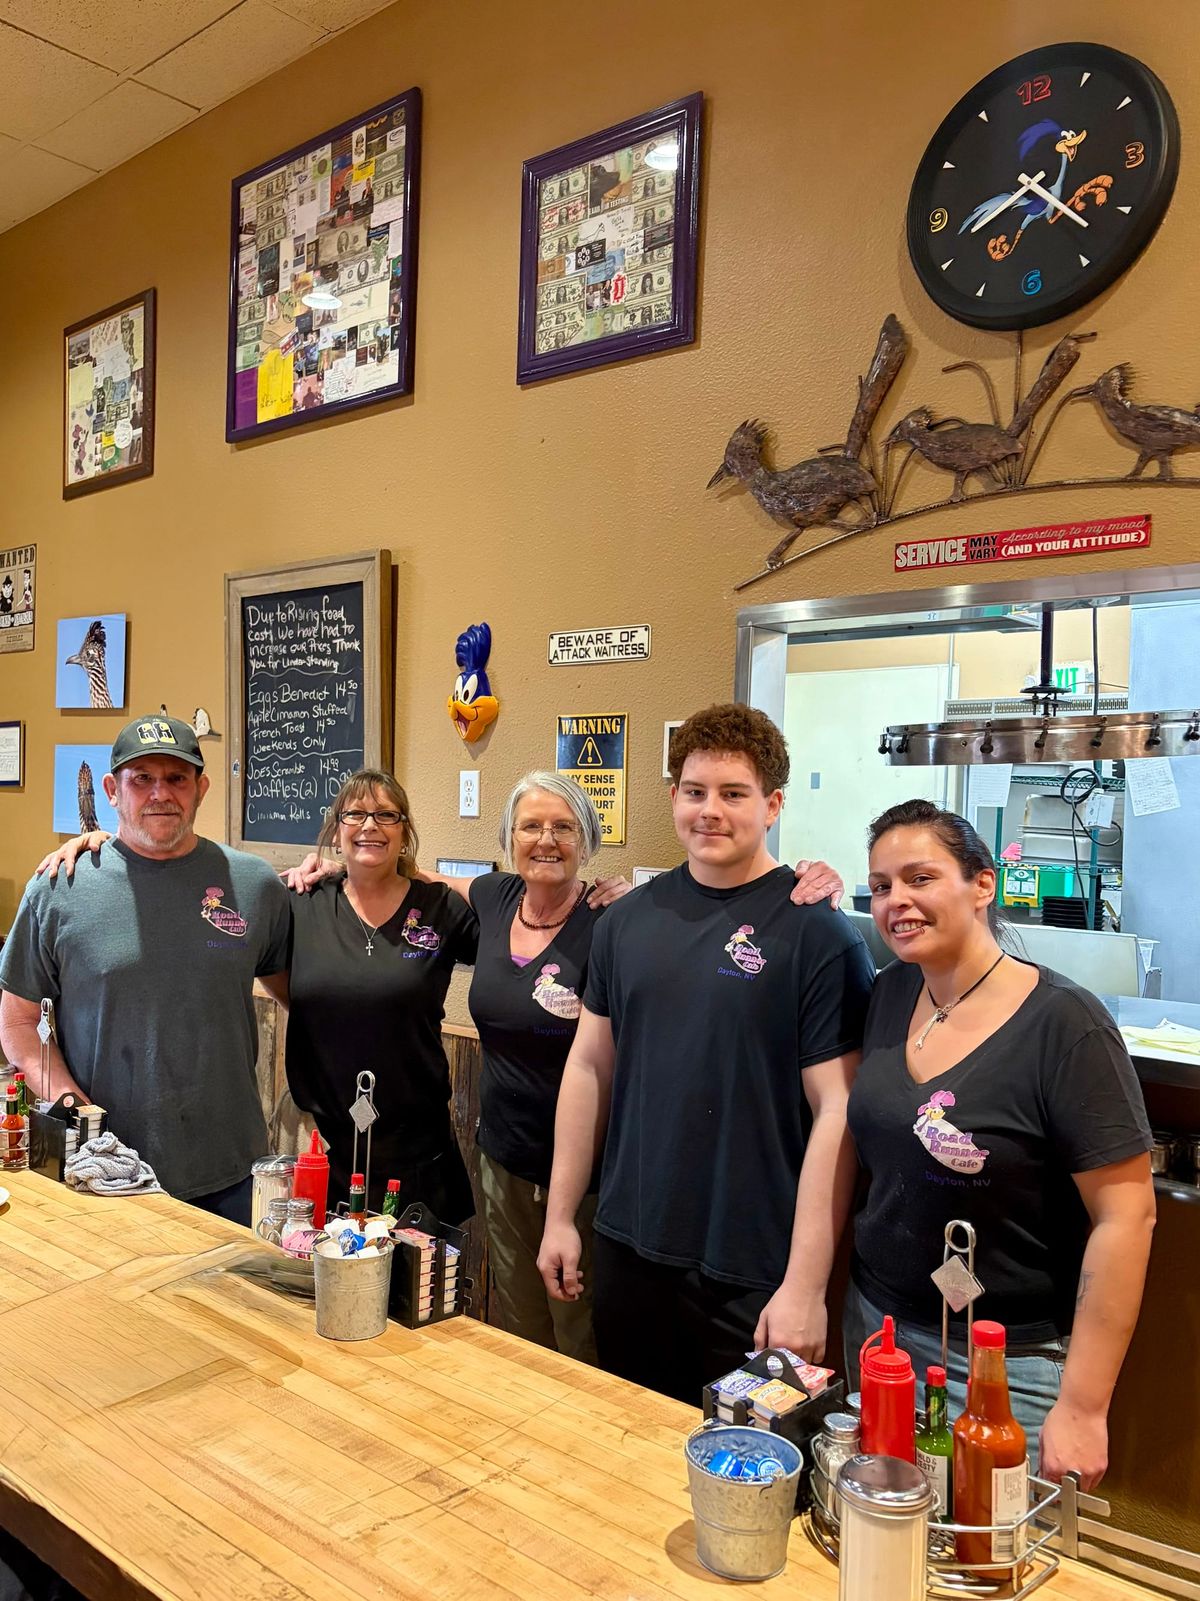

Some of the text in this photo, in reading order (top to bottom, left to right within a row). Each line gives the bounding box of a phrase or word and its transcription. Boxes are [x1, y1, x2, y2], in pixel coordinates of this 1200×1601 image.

[1016, 74, 1052, 106] 12
[1125, 142, 1144, 169] 3
[929, 208, 948, 233] 9
[1021, 269, 1042, 296] 6
[1002, 518, 1146, 544] According to my mood
[969, 535, 998, 549] MAY
[1000, 529, 1146, 557] (AND YOUR ATTITUDE)
[0, 547, 35, 568] WANTED
[896, 538, 966, 568] SERVICE
[969, 547, 998, 561] VARY
[276, 602, 287, 623] to
[285, 600, 320, 628] Rising
[278, 626, 294, 640] We
[297, 623, 319, 639] have
[321, 621, 340, 639] had
[342, 618, 355, 636] to
[558, 630, 638, 648] BEWARE OF
[249, 643, 287, 658] increase
[332, 638, 361, 654] Thank
[552, 643, 645, 660] ATTACK WAITRESS
[267, 655, 280, 669] for
[1055, 667, 1079, 694] XIT
[249, 682, 278, 711] Eggs
[279, 683, 330, 703] Benedict
[248, 710, 270, 729] Apple
[312, 702, 348, 719] Stuffed
[250, 727, 281, 742] French
[282, 722, 305, 735] Toast
[561, 718, 620, 736] WARNING
[303, 736, 326, 751] Only
[584, 775, 616, 784] SENSE
[284, 802, 311, 823] Rolls
[594, 800, 615, 809] URT
[926, 1126, 973, 1146] Road
[930, 1140, 989, 1160] Runner
[951, 1158, 978, 1169] Cafe
[973, 1178, 991, 1187] NV
